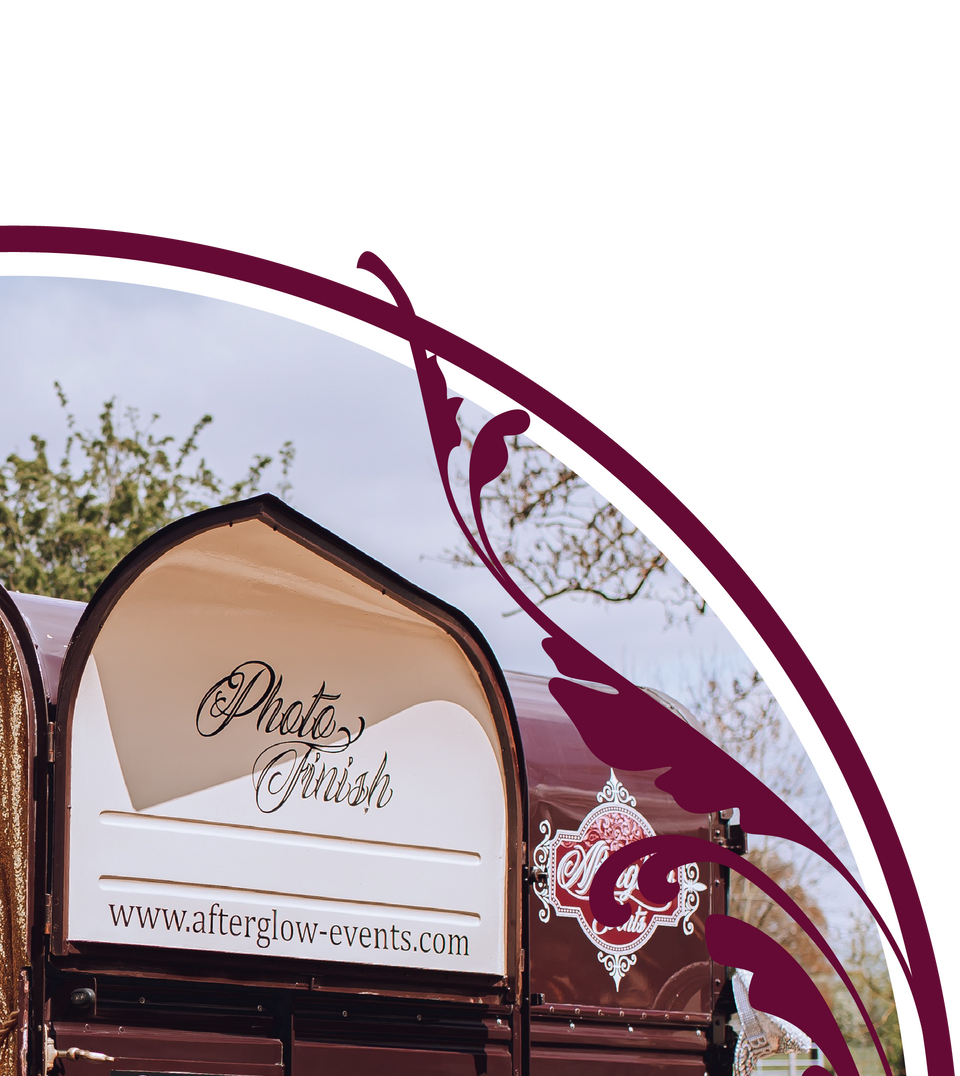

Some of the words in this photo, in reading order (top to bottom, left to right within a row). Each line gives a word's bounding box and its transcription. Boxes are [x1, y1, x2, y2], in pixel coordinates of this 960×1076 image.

[196, 660, 366, 748] Photo
[252, 740, 393, 814] Finish
[108, 902, 470, 956] www.afterglow-events.com
